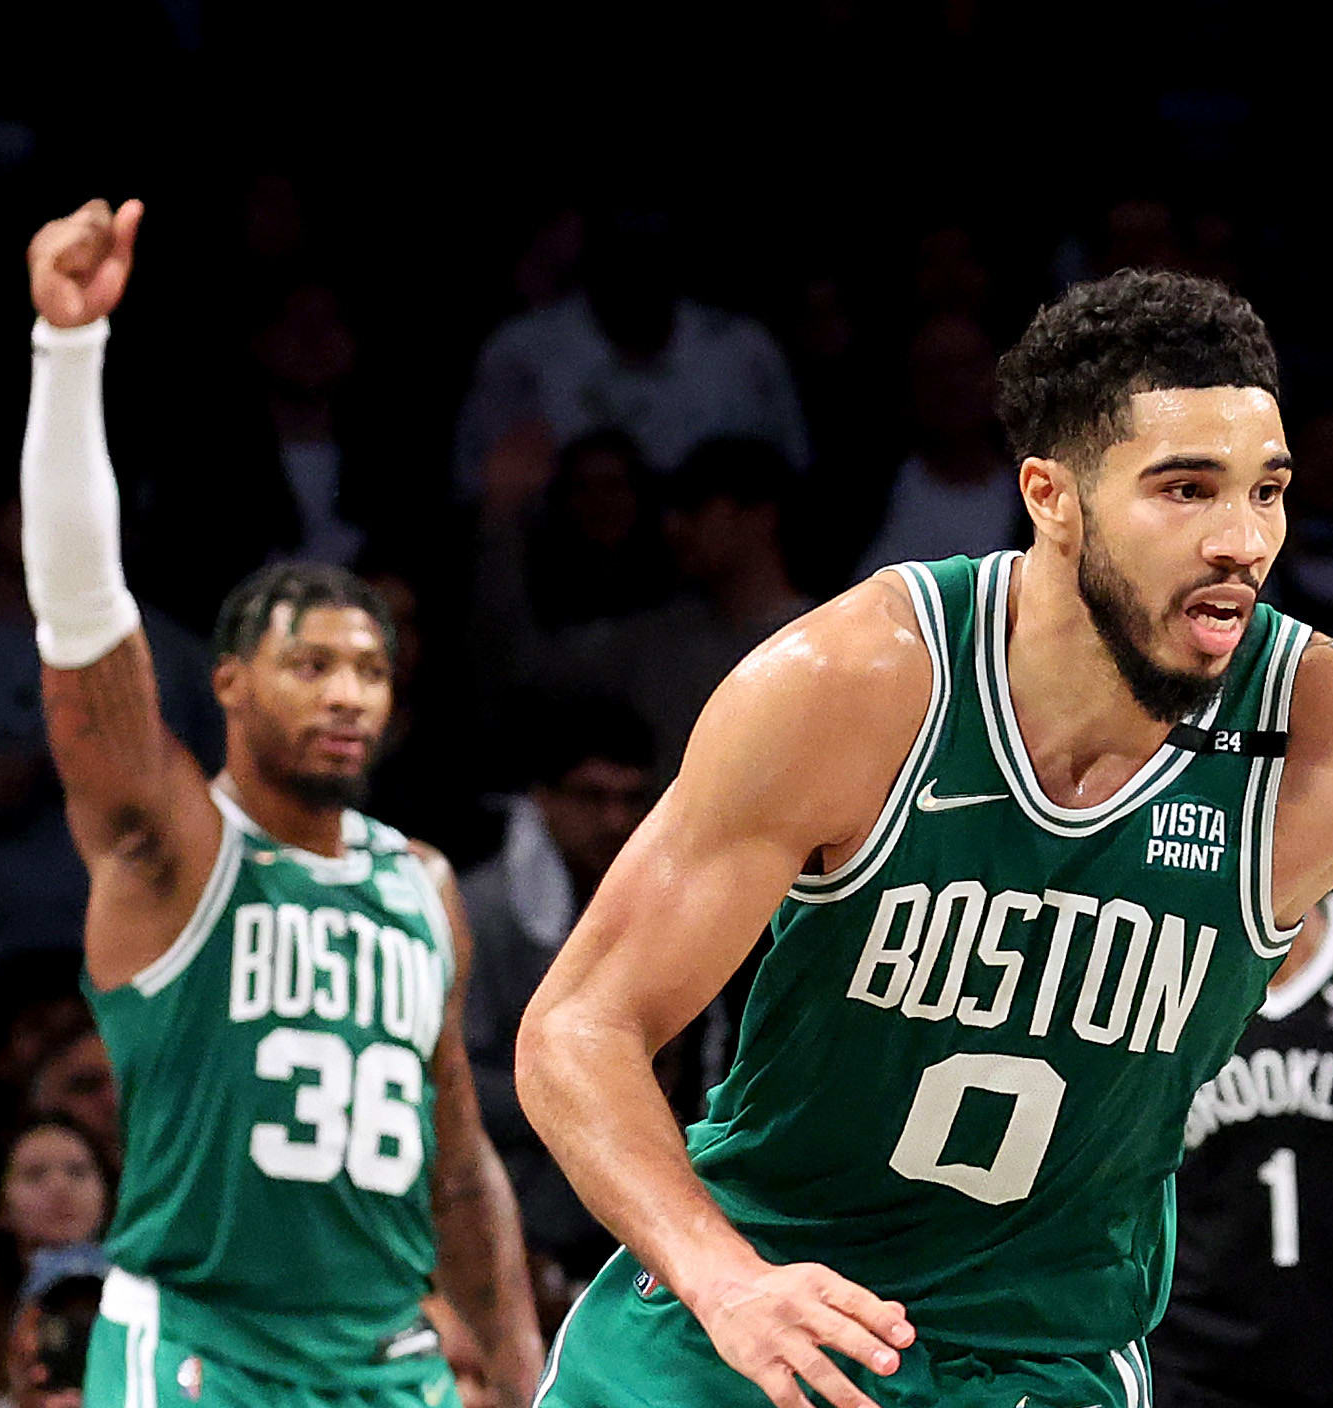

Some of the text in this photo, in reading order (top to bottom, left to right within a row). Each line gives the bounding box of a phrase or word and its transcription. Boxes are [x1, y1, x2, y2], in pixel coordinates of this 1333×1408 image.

[1214, 730, 1242, 753] 24
[1145, 838, 1225, 872] PRINT
[1151, 802, 1226, 846] VISTA
[229, 902, 446, 1062] BOSTON
[846, 880, 1218, 1053] BOSTON
[249, 1026, 424, 1197] 36
[888, 1052, 1067, 1206] 0
[1256, 1147, 1301, 1268] 1
